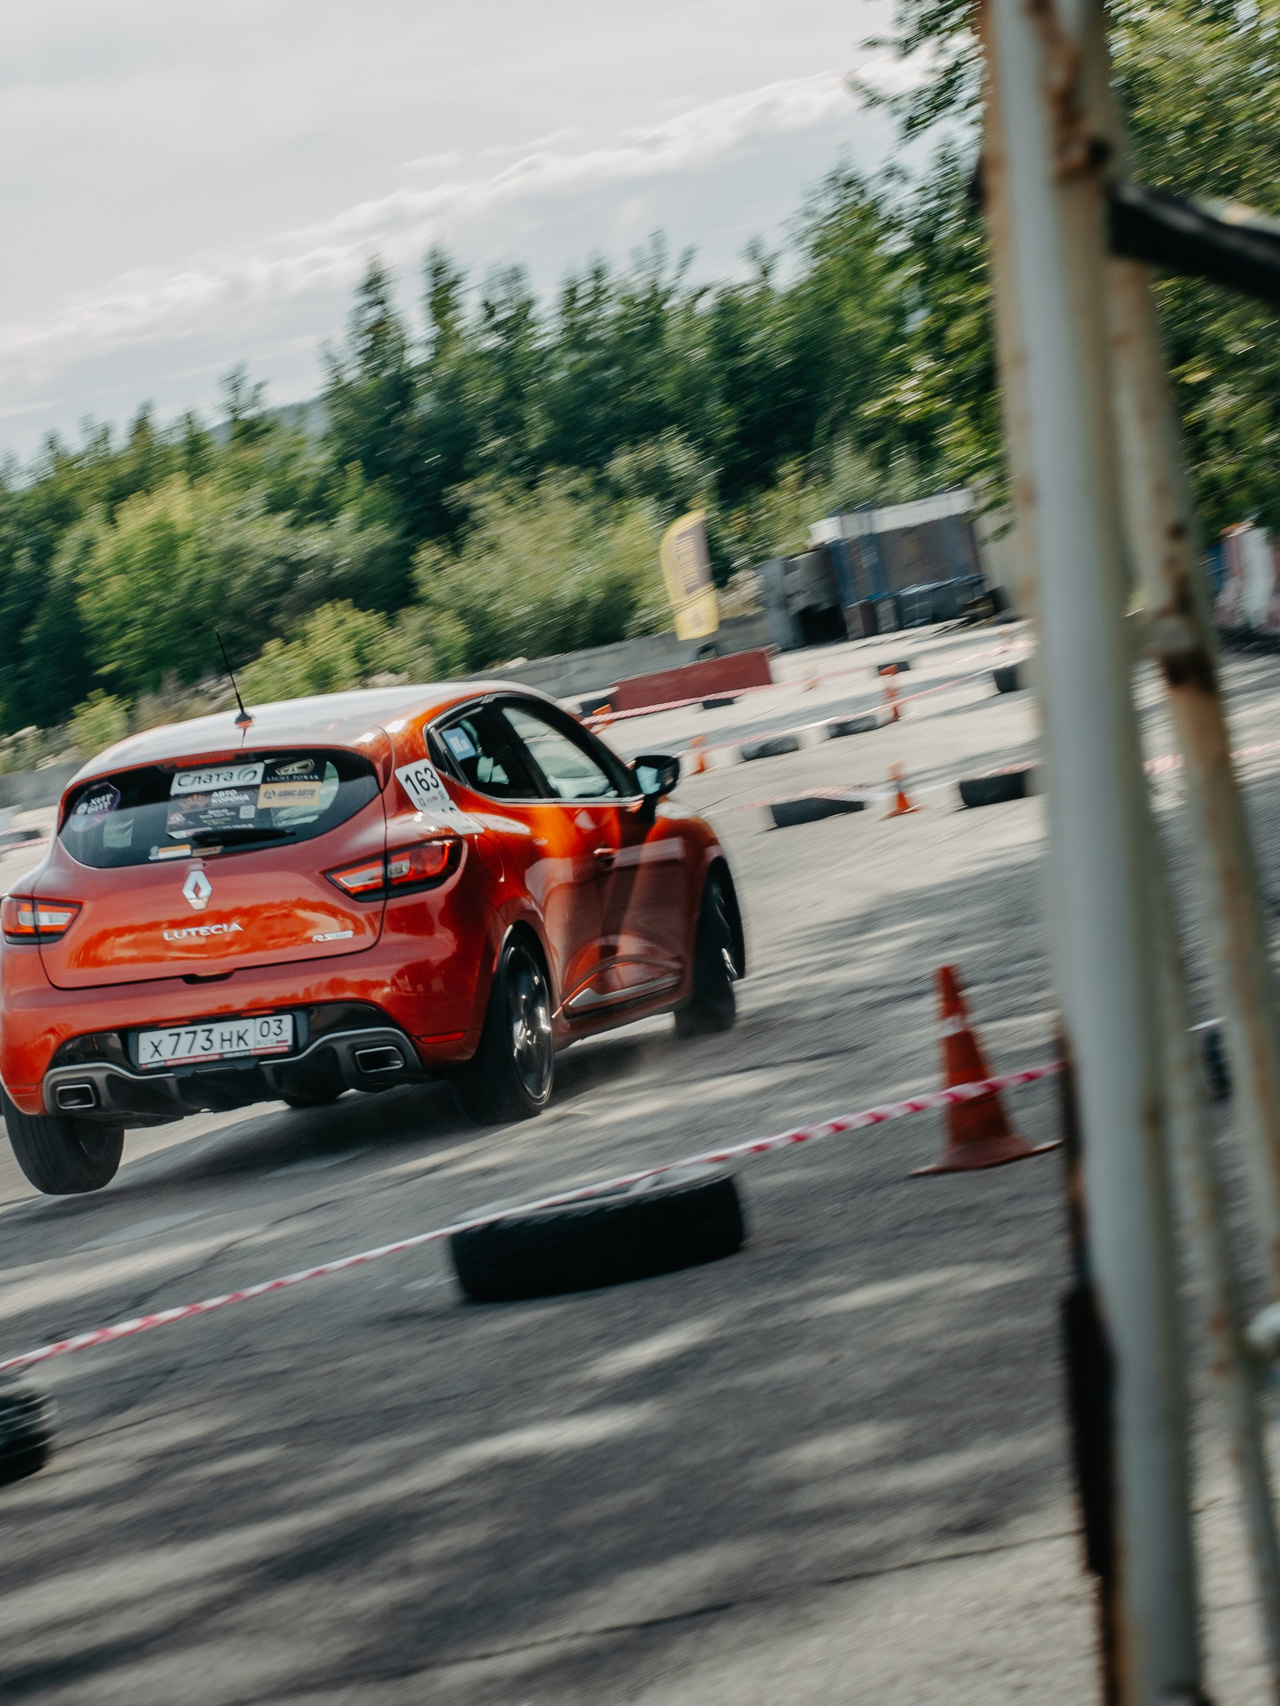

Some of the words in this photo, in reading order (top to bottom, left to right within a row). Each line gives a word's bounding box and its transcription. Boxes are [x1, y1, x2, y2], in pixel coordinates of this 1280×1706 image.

[177, 770, 234, 788] Слата
[404, 767, 440, 795] 163
[163, 922, 244, 942] LUTECIA
[259, 1019, 284, 1038] 03
